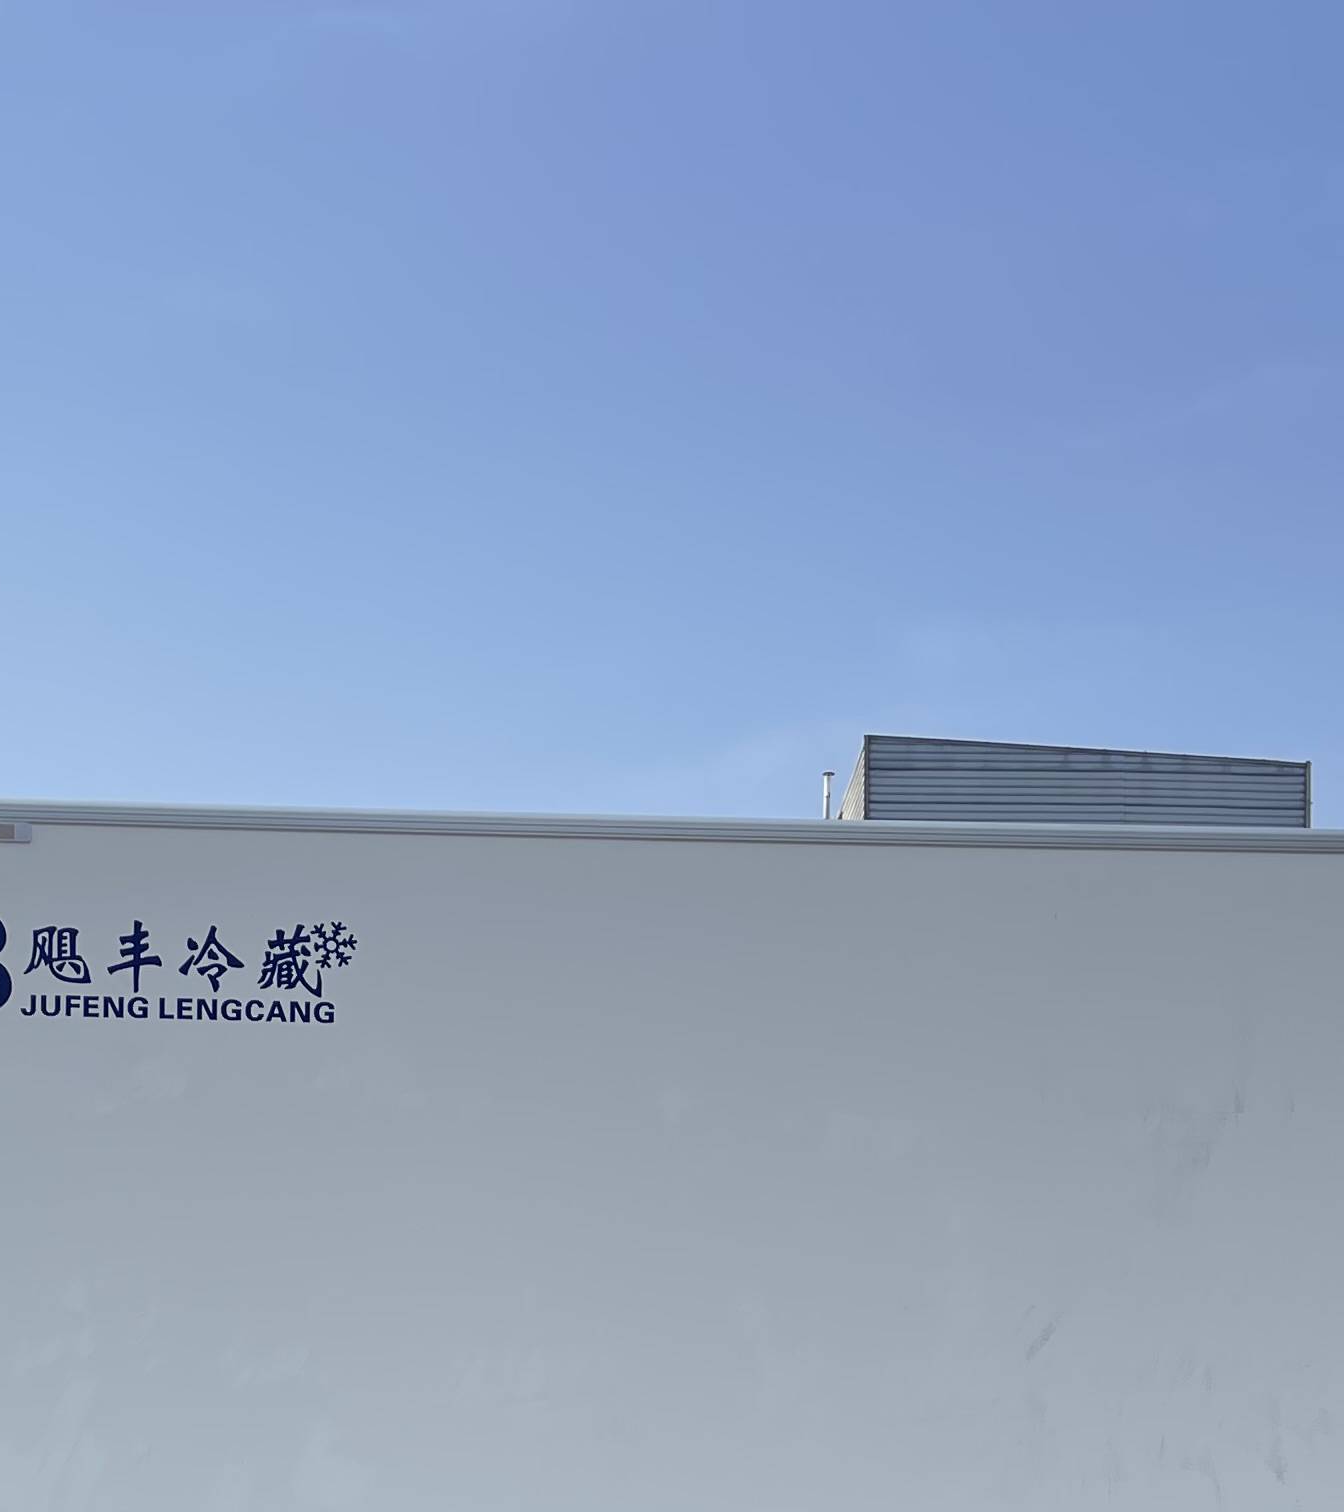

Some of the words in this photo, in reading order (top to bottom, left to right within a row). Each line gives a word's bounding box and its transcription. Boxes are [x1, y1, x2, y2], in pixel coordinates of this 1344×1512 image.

[24, 920, 322, 998] 飓丰冷藏
[20, 994, 149, 1019] JUFENG
[159, 997, 336, 1024] LENGCANG
